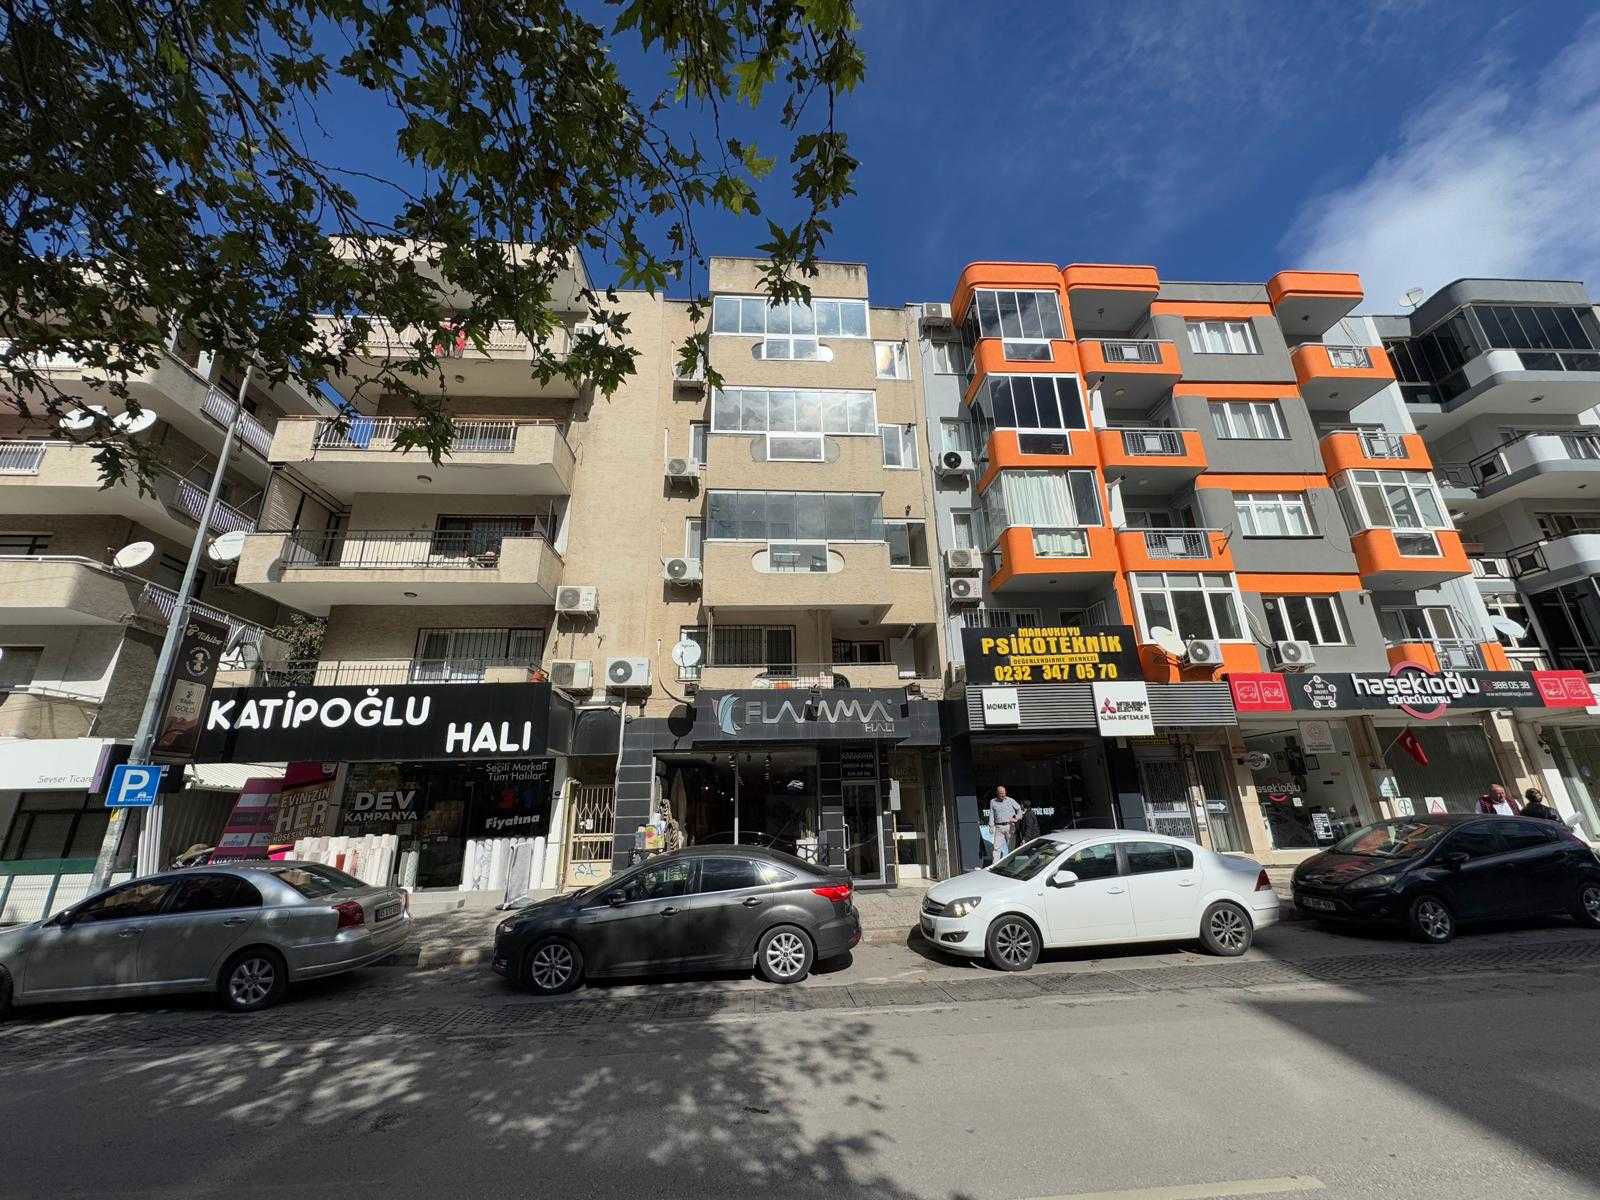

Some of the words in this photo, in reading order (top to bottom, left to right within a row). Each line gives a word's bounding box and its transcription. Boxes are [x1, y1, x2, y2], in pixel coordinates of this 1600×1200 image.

[981, 632, 1122, 655] PSİKOTEKNİK
[994, 665, 1032, 682] 0232
[1042, 665, 1070, 680] 347
[1075, 664, 1095, 679] 05
[1098, 663, 1118, 679] 70
[1351, 671, 1480, 698] hasekioğlu
[1492, 681, 1509, 689] 388
[1387, 694, 1423, 705] sürücü
[1423, 695, 1451, 704] kursu
[986, 703, 1016, 711] MOMENT
[207, 688, 431, 730] KATİPOĞLU
[446, 721, 532, 753] HALI
[865, 723, 895, 732] HALI
[485, 763, 510, 774] Seçili
[488, 772, 508, 781] Tüm
[511, 771, 543, 781] Halılar
[117, 769, 150, 802] P
[1256, 781, 1301, 795] asekioğlu
[354, 790, 416, 811] DEV
[275, 801, 327, 835] HER
[345, 811, 418, 822] KAMPANYA
[485, 815, 540, 830] Fiyatına
